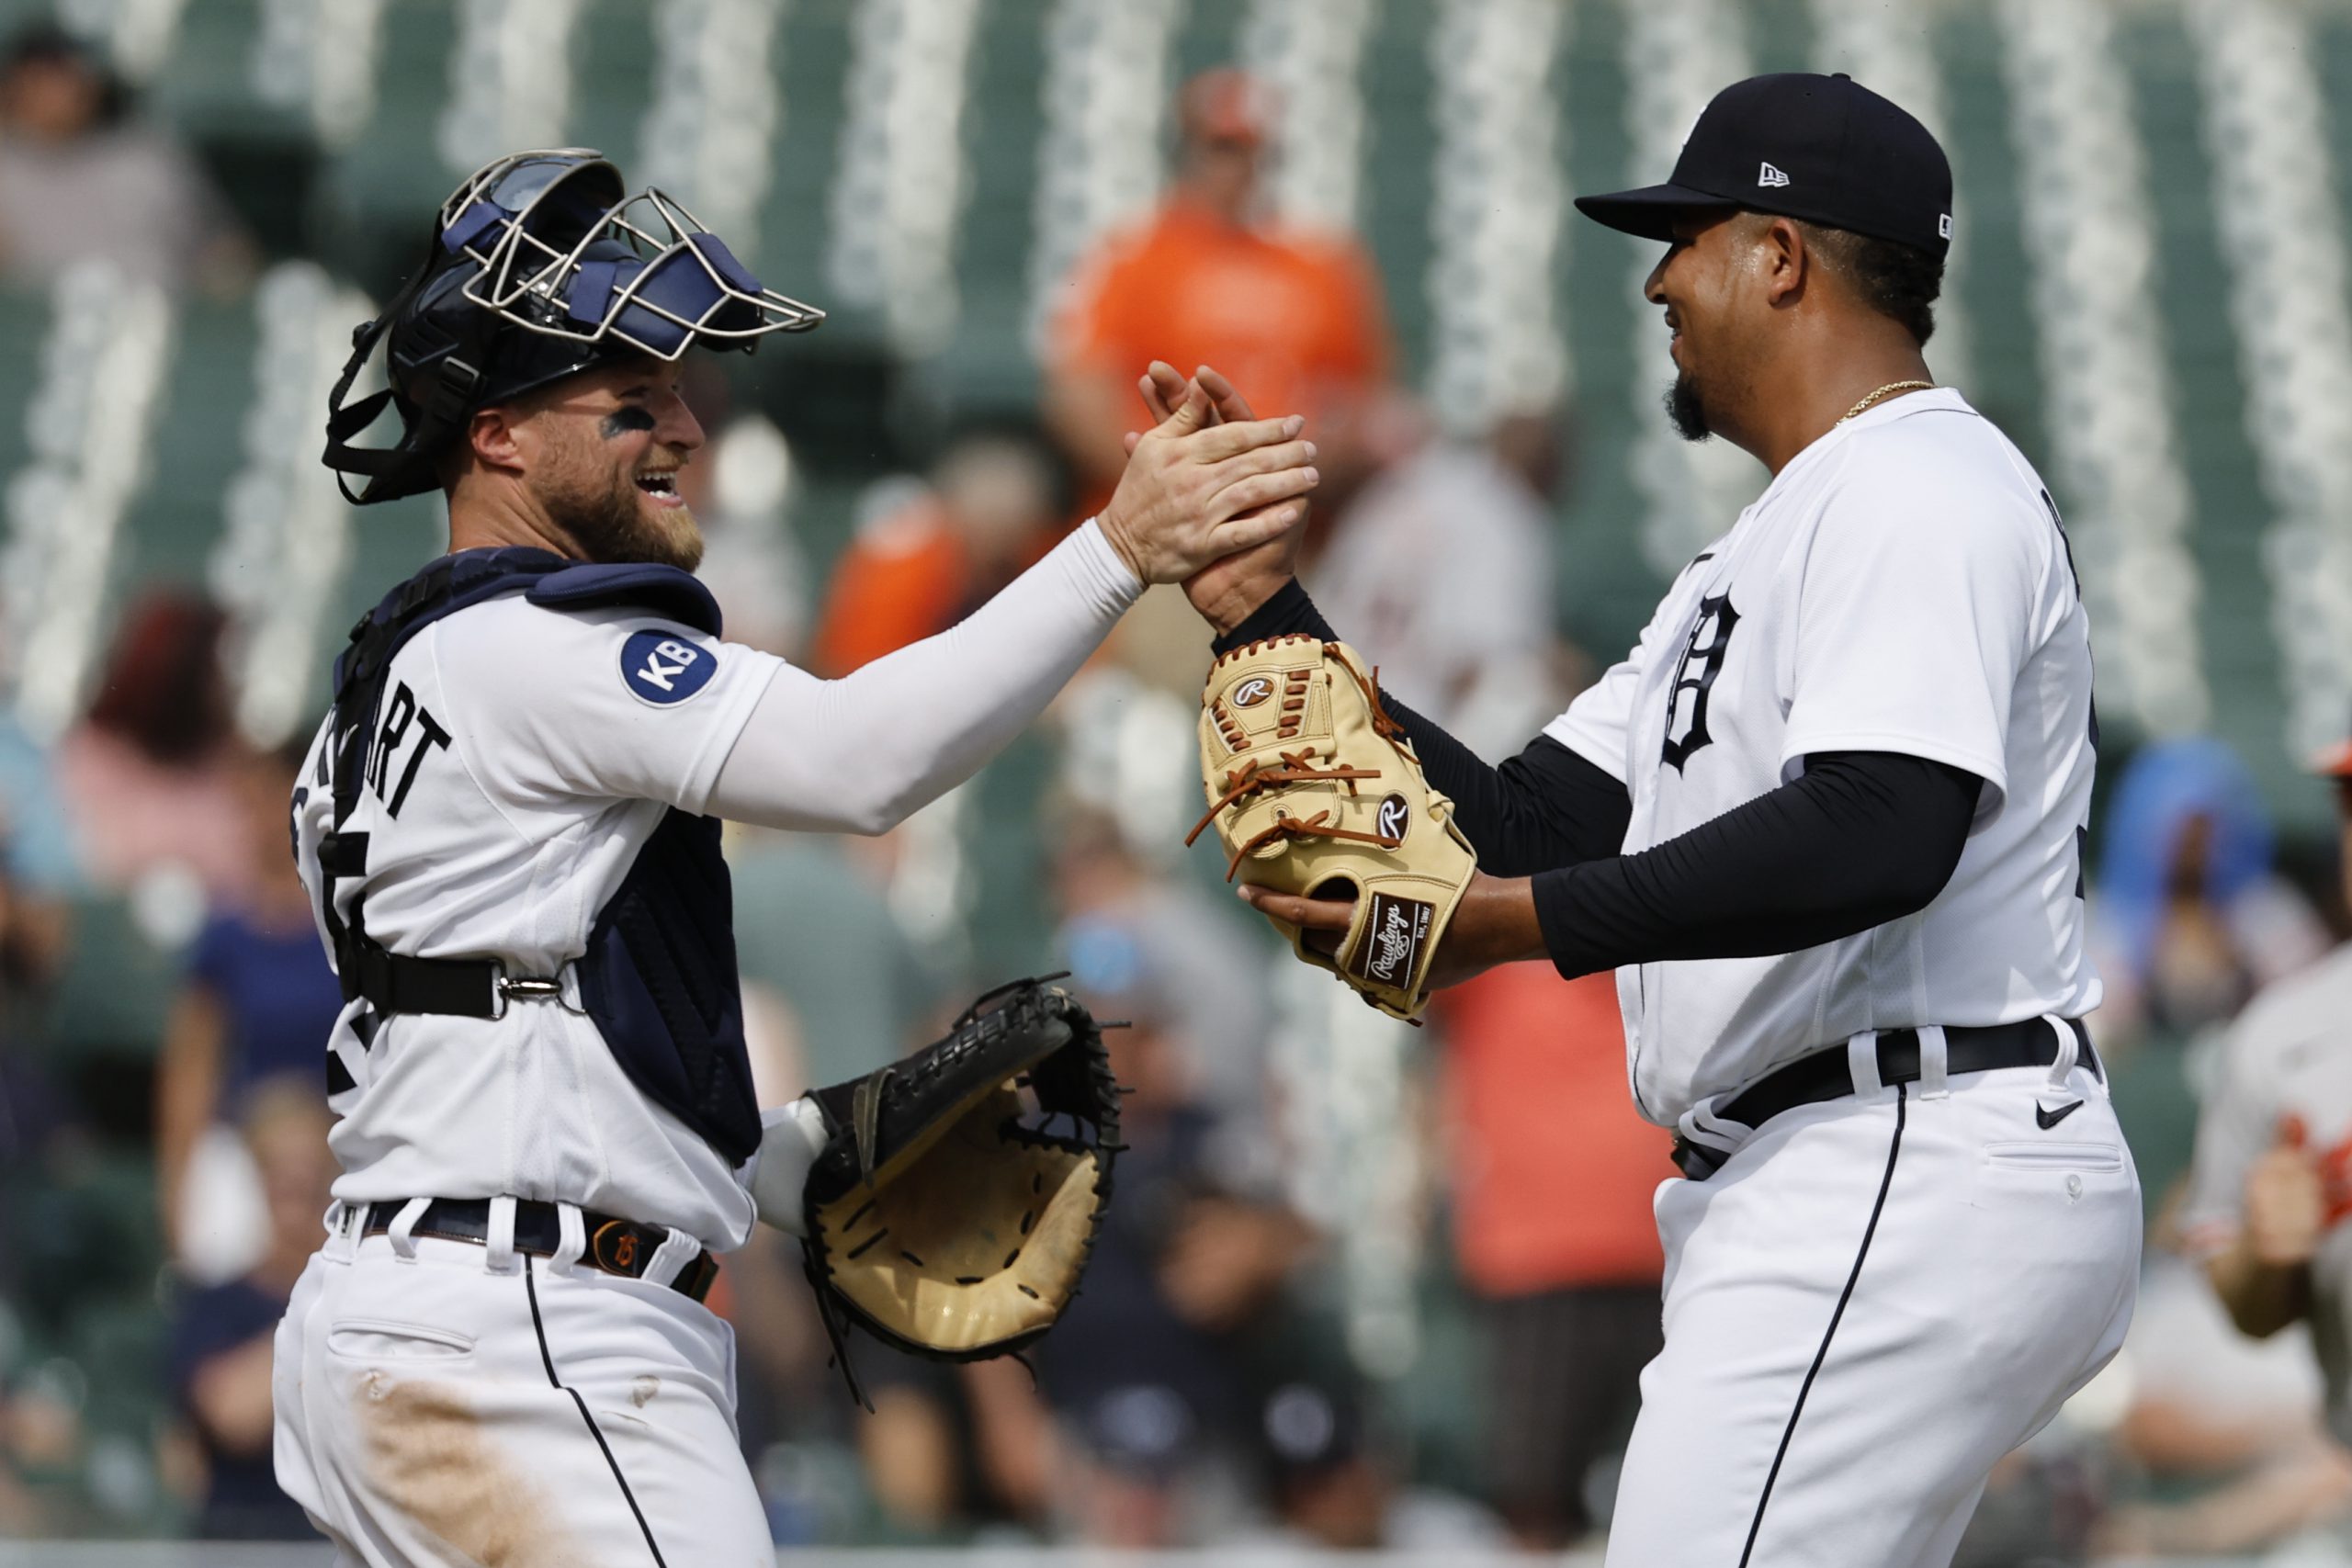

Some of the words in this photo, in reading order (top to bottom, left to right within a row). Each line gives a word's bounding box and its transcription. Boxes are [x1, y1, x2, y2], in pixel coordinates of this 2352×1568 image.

[637, 640, 698, 692] KB
[1236, 680, 1270, 705] R
[1379, 799, 1408, 840] R
[1371, 904, 1409, 980] Rawlings
